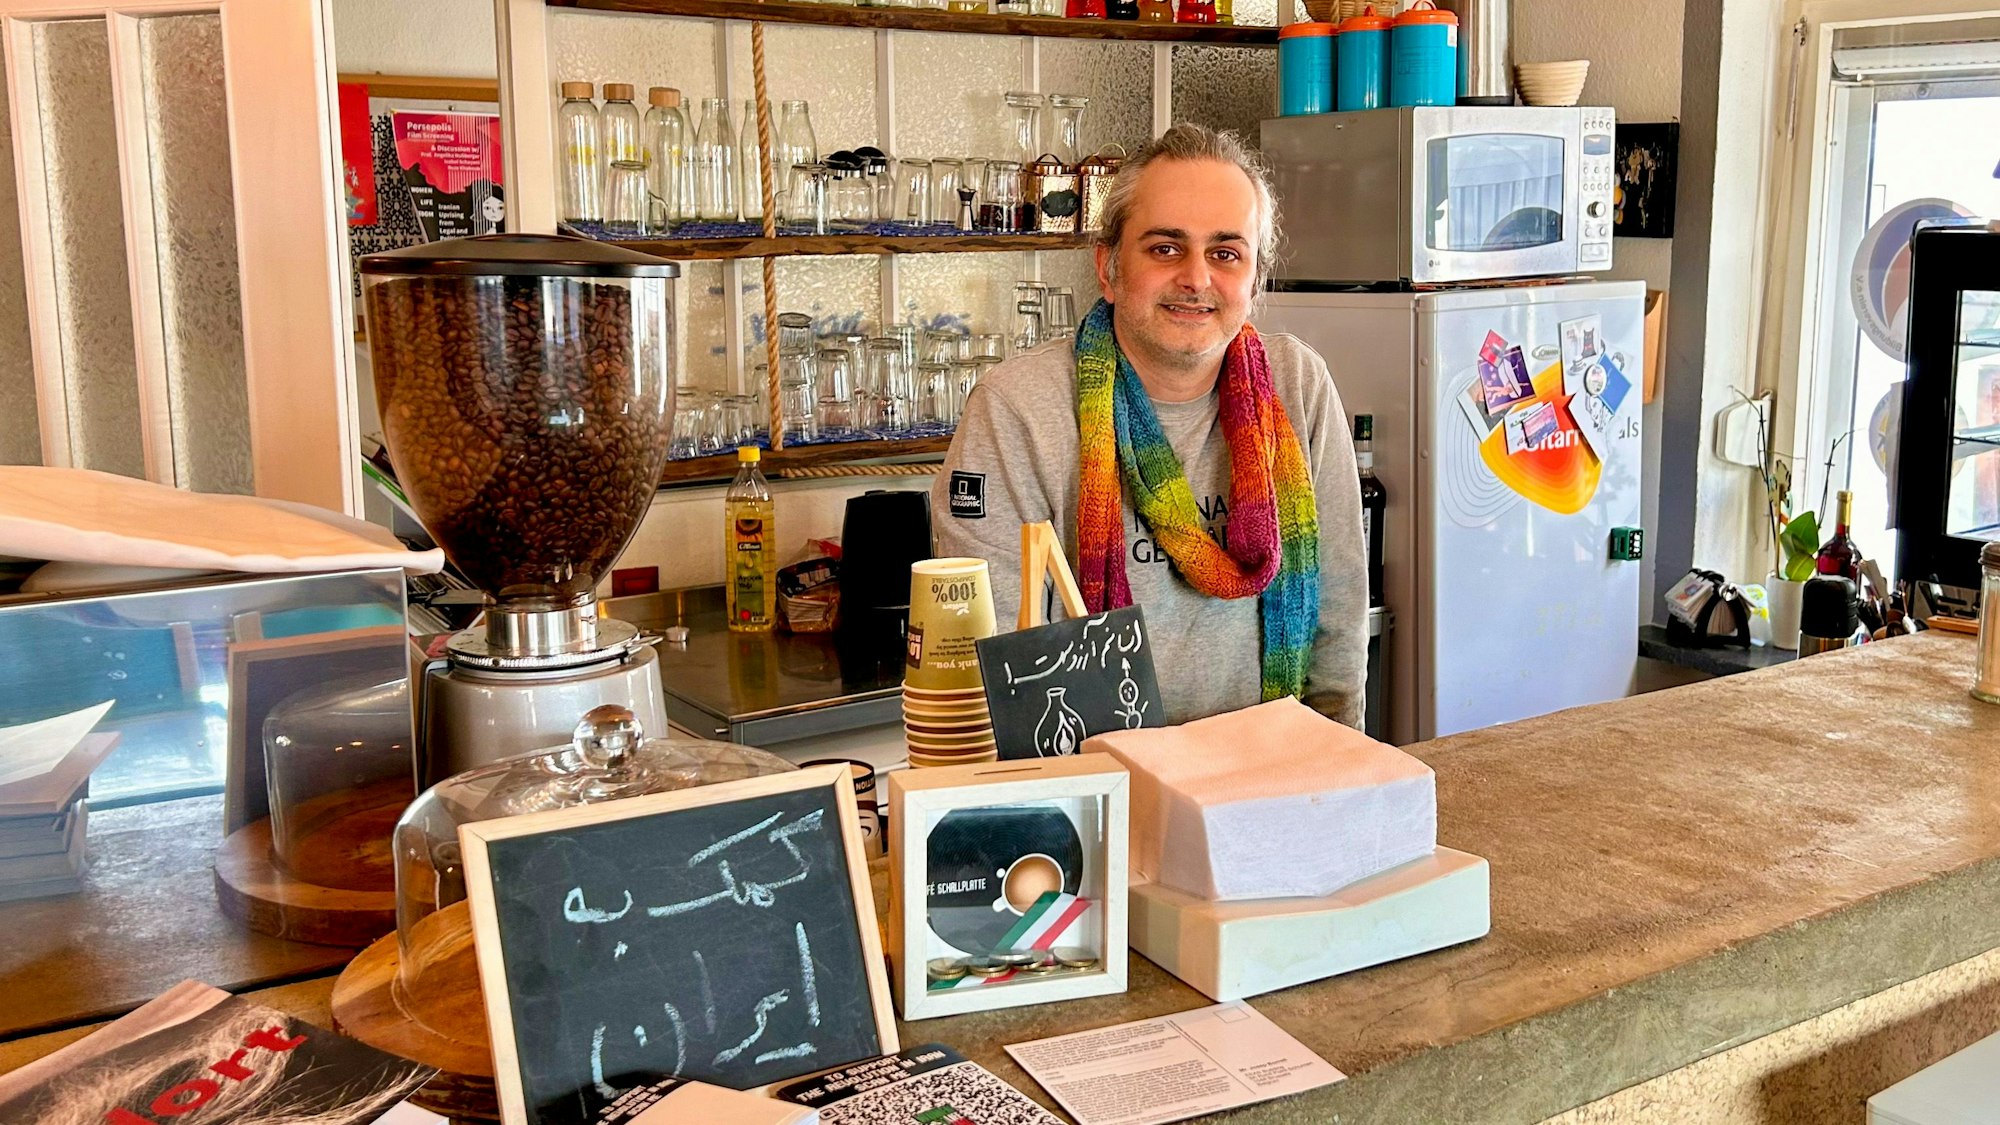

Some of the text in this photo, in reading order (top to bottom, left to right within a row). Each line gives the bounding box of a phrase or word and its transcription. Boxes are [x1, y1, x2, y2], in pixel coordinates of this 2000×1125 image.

[407, 121, 452, 132] Persepolis
[423, 133, 454, 141] Screening
[439, 212, 465, 220] Uprising
[932, 575, 976, 583] COMPOSTABLE
[931, 582, 977, 603] 100%
[957, 659, 978, 670] ank
[927, 878, 987, 896] FÉ SCHALLPLATTE
[563, 885, 634, 962] به
[796, 1050, 946, 1102] THE REVOLUTION IN IRAN
[823, 1055, 901, 1083] TO SUPPORT
[854, 1069, 911, 1092] SCAN ME
